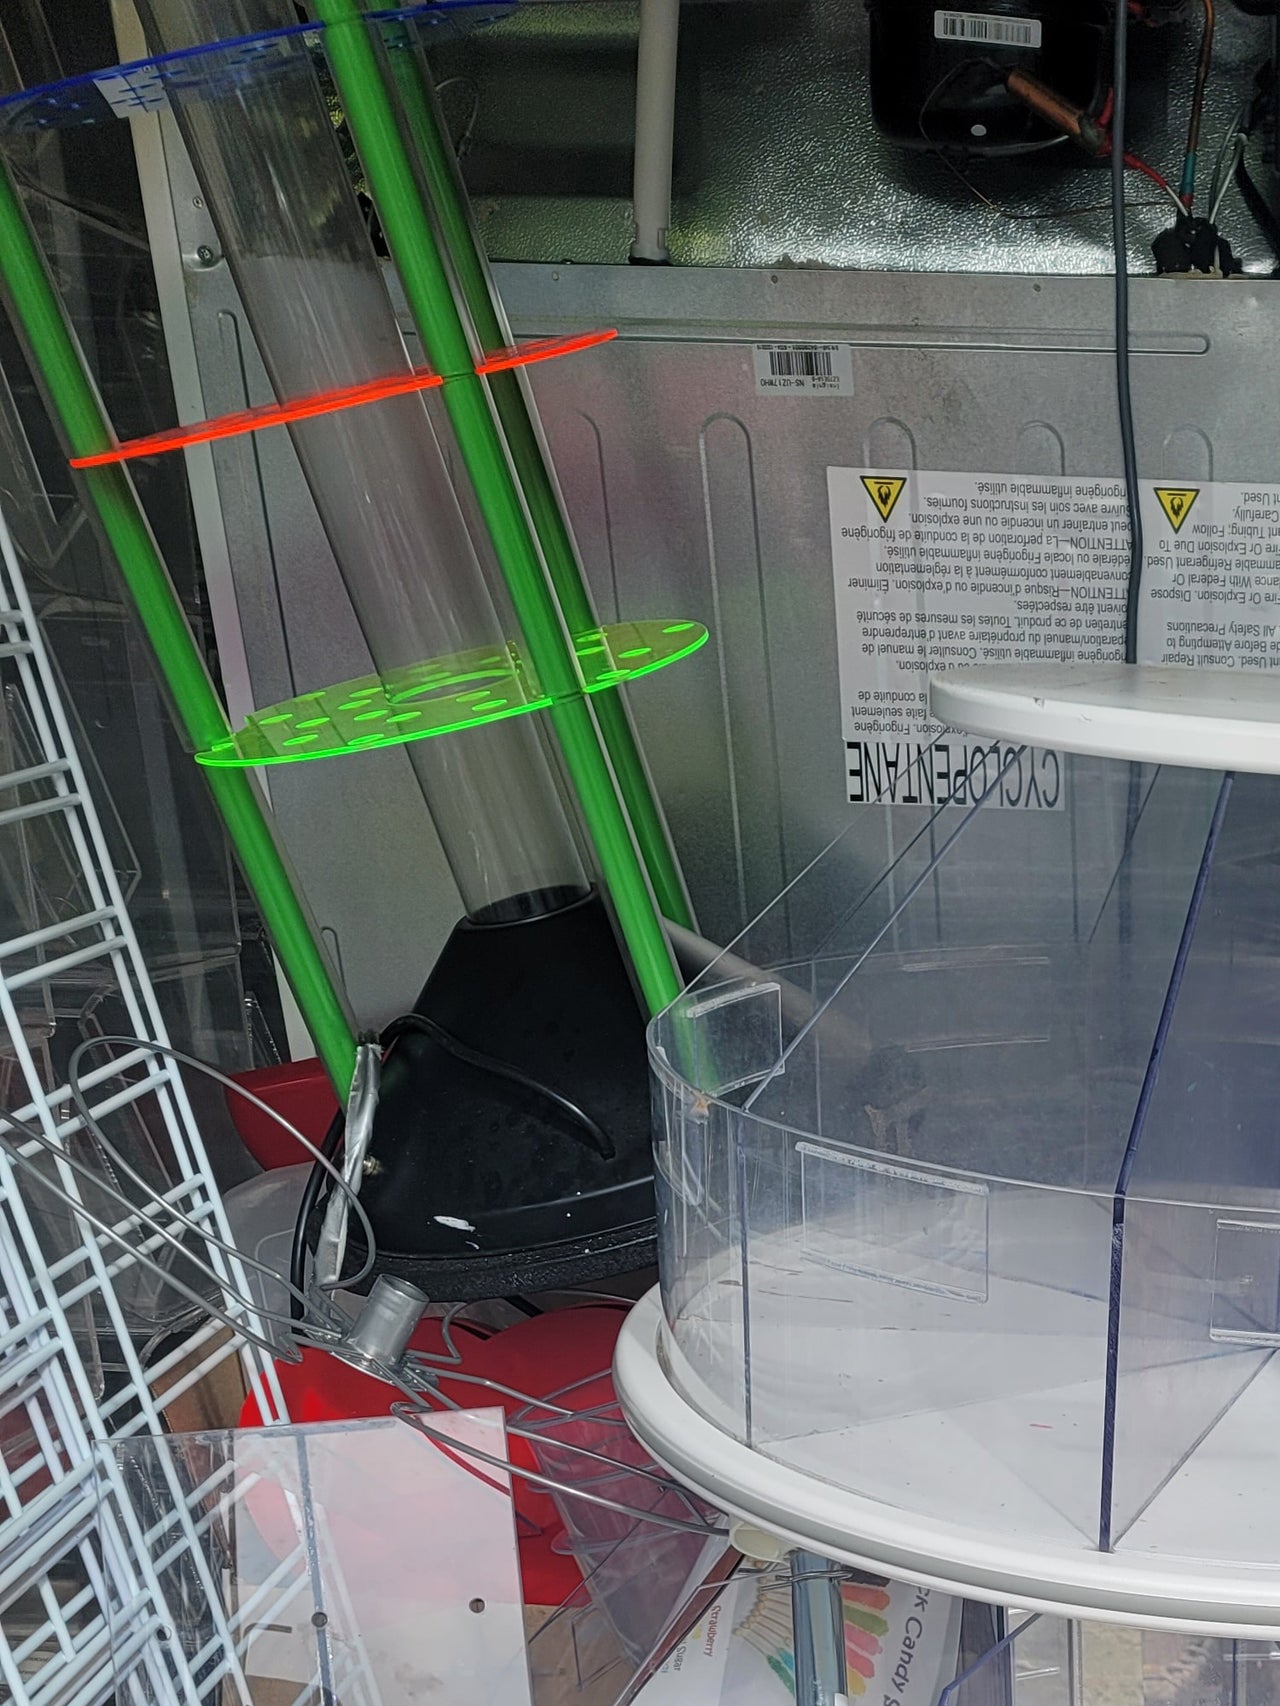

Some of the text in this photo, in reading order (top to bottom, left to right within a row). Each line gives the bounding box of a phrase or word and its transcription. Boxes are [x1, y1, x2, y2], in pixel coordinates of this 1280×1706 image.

[1076, 484, 1126, 499] rigorigène
[1241, 493, 1270, 506] Used.
[1233, 507, 1279, 523] Carefully.
[1192, 525, 1224, 538] Follow
[1229, 523, 1265, 539] Tubing;
[1159, 540, 1171, 553] To
[1174, 541, 1194, 554] Due
[1198, 539, 1246, 555] Explosion
[1250, 543, 1262, 556] Or
[1093, 554, 1130, 567] édérale
[1145, 557, 1173, 569] Used.
[1176, 555, 1232, 571] Refrigerant
[1172, 574, 1185, 586] Or
[1188, 574, 1226, 588] Federal
[1230, 576, 1252, 588] With
[1151, 587, 1191, 603] Dispose
[1195, 588, 1246, 604] Explosion.
[1249, 592, 1261, 605] Or
[1167, 622, 1225, 636] Precautions
[1229, 621, 1260, 636] Safety
[1264, 625, 1276, 637] All
[1044, 632, 1126, 648] paration/manuel
[1167, 638, 1176, 650] to
[1179, 636, 1232, 652] Attempting
[1234, 640, 1266, 653] Before
[1078, 649, 1126, 664] igorigène
[1161, 652, 1194, 666] Repair
[1198, 655, 1235, 668] Consult
[1239, 656, 1266, 668] Used.
[846, 742, 1060, 808] CYCLOPENTANE
[890, 1616, 923, 1691] Candy
